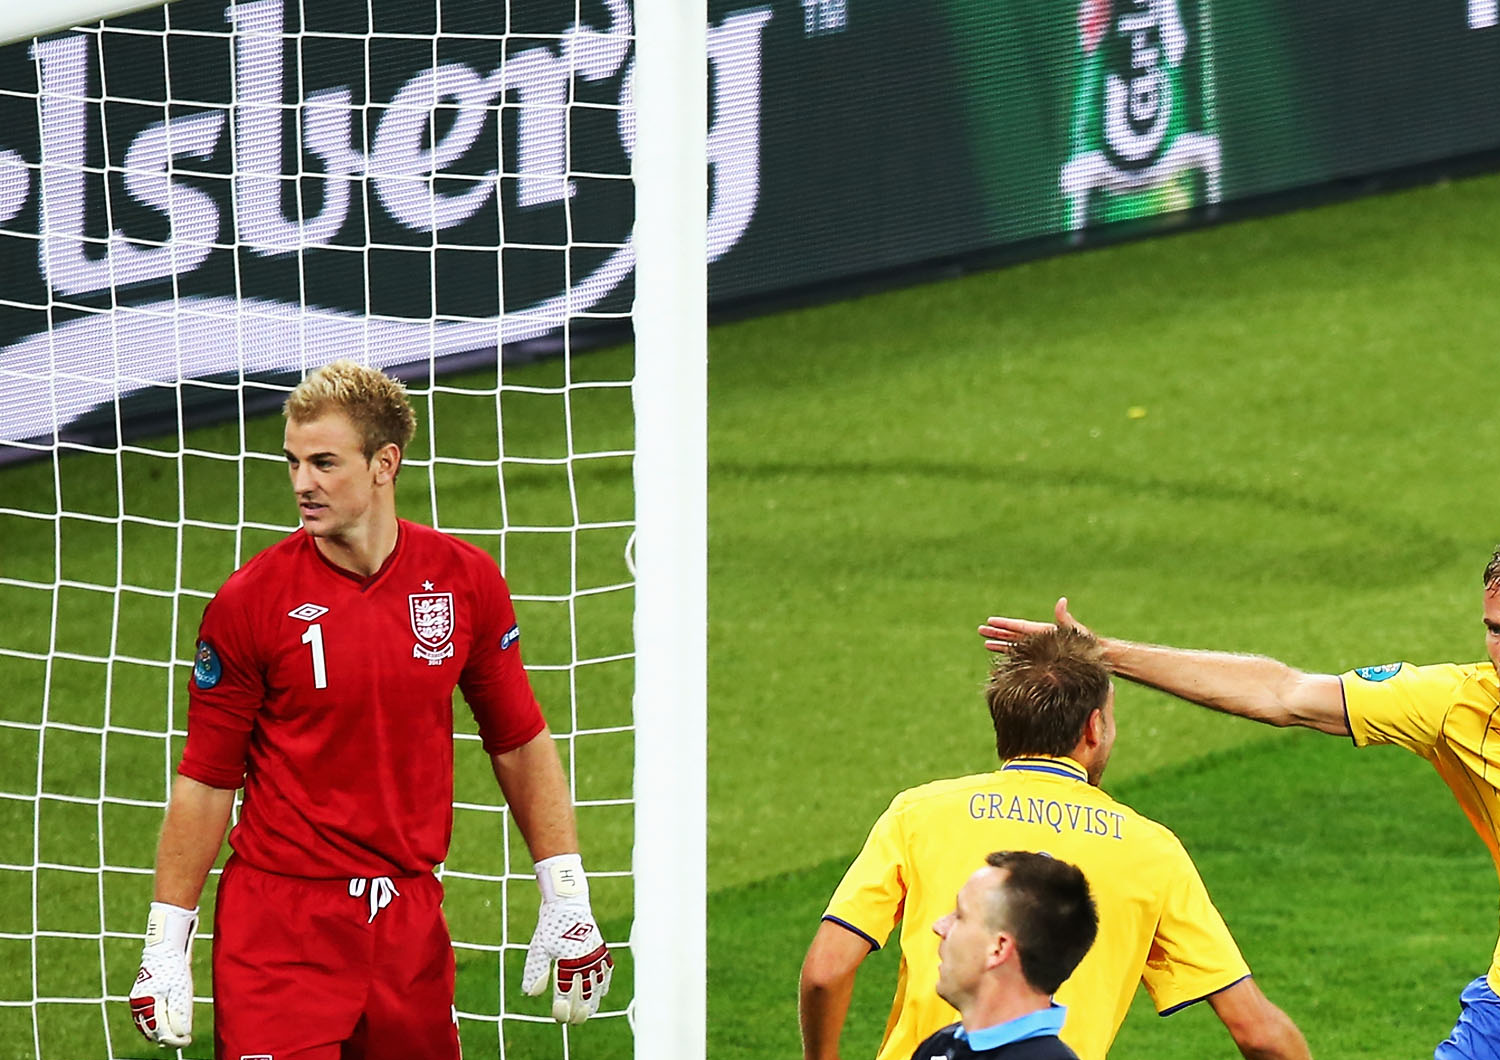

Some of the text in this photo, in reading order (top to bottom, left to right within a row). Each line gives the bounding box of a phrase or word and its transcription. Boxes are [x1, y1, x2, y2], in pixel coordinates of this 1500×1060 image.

[0, 0, 773, 298] lsberg
[301, 623, 328, 689] 1
[969, 793, 1125, 840] GRANQVIST
